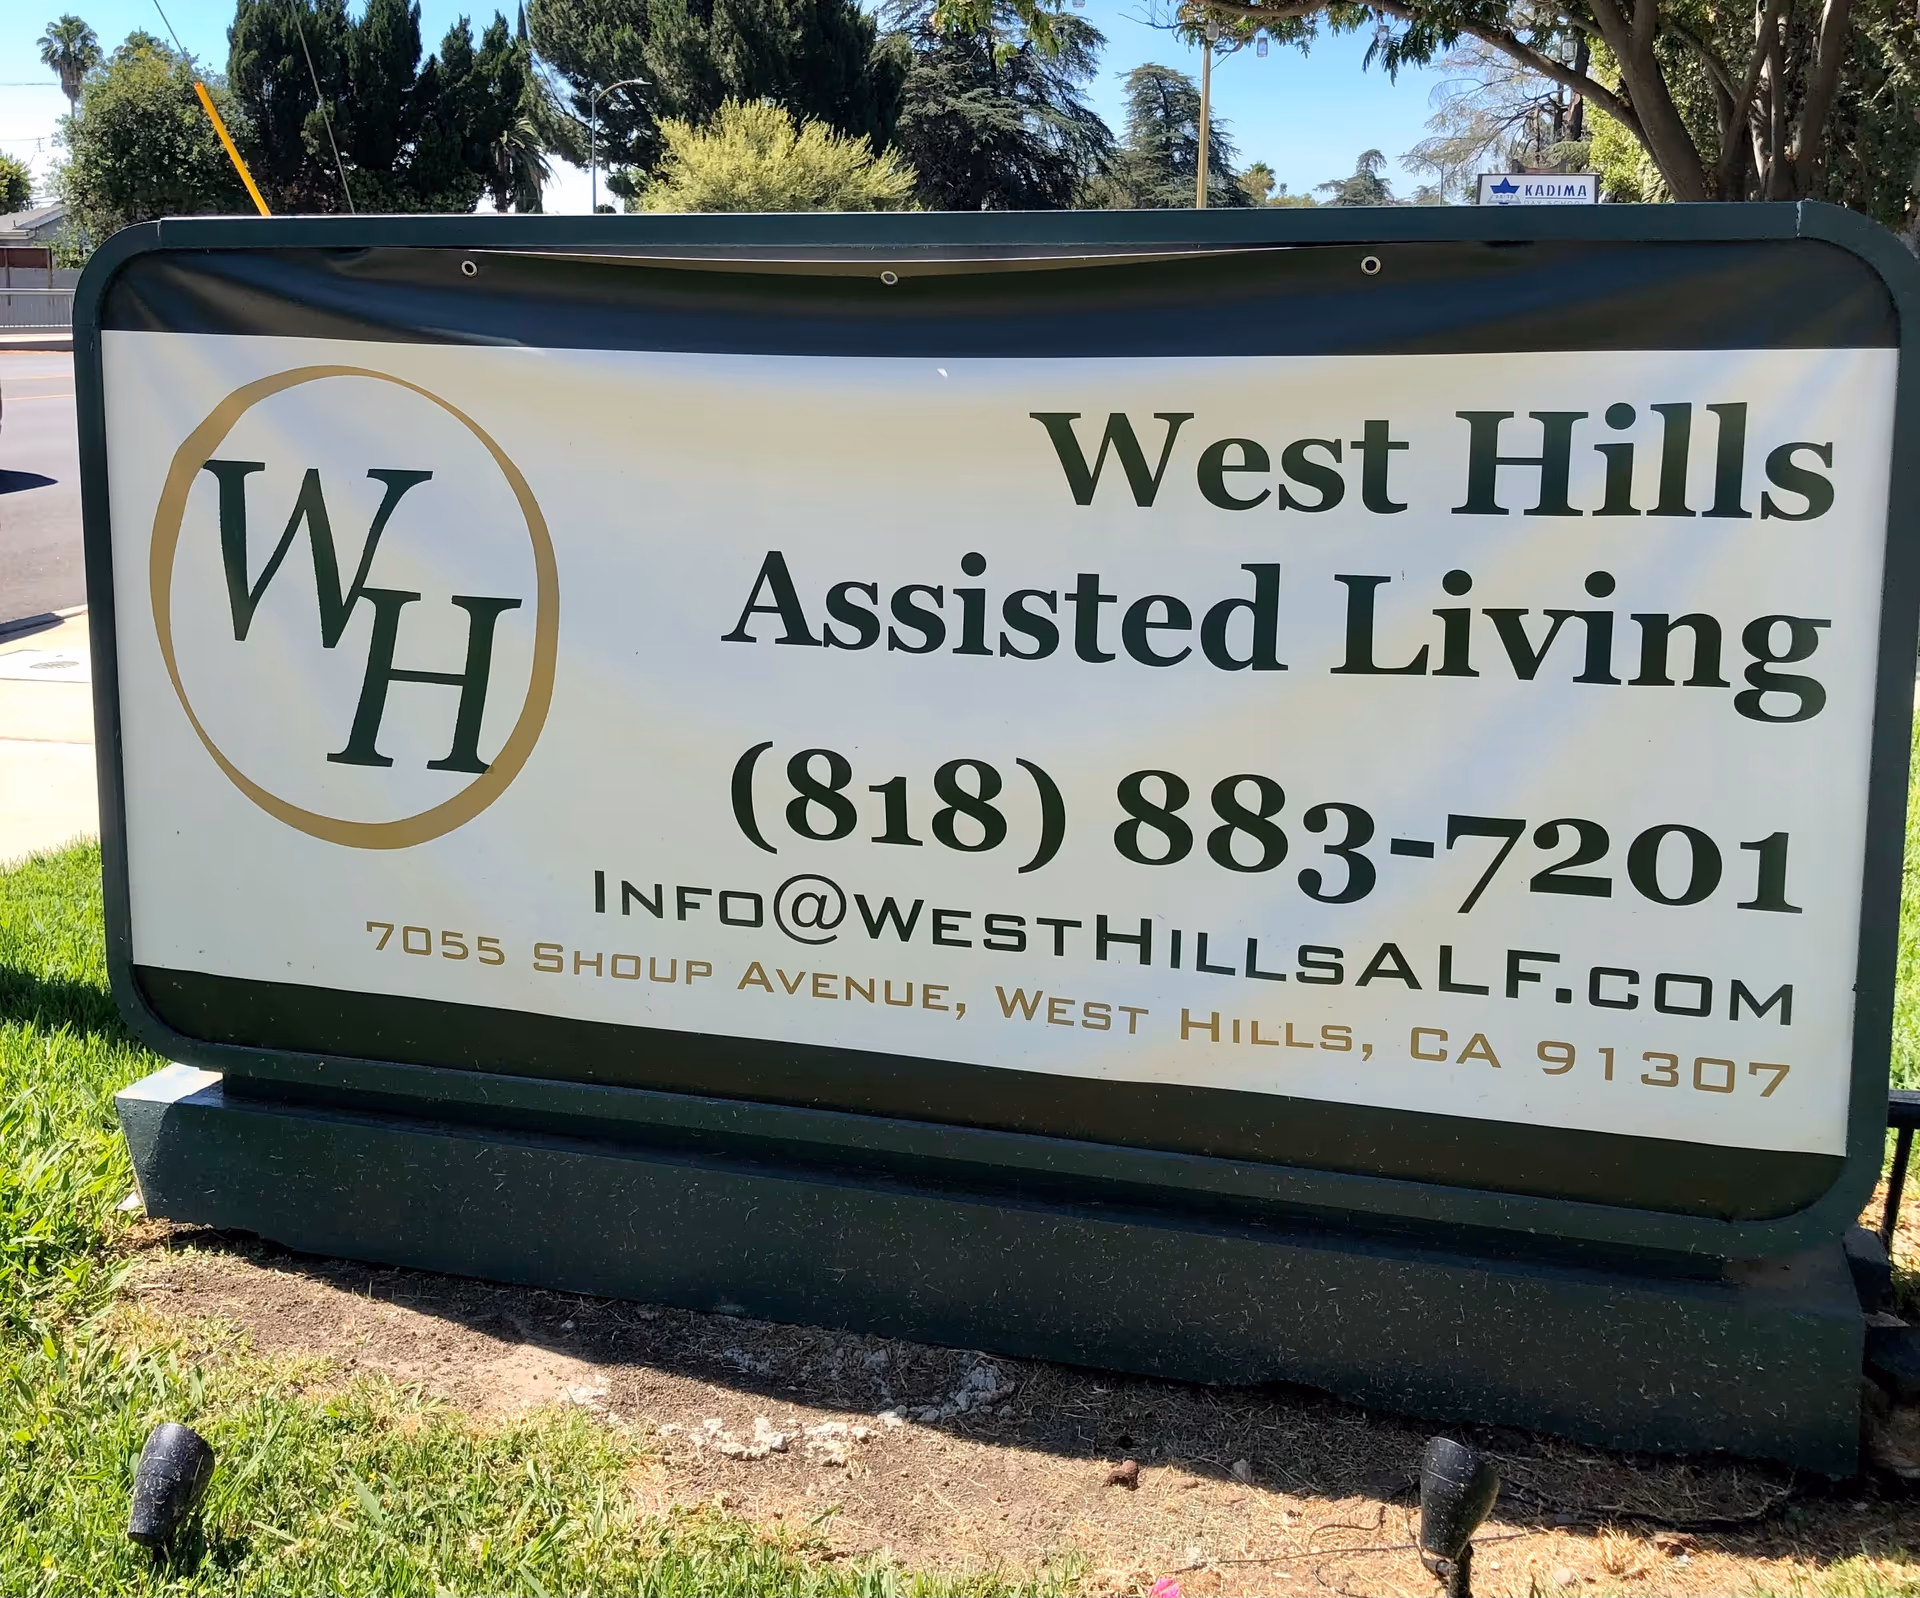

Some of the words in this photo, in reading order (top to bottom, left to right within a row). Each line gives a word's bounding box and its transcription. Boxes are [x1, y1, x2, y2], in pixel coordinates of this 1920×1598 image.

[1525, 184, 1587, 196] KADIMA
[1029, 412, 1410, 514] West
[1451, 402, 1834, 521] Hills
[721, 551, 1288, 671] Assisted
[1330, 569, 1831, 723] Living
[731, 741, 1065, 874] (818)
[1114, 770, 1802, 913] 883-7201
[367, 921, 505, 965] 7055
[533, 943, 713, 984] SHOUP
[737, 962, 966, 1020] AVENUE,
[995, 986, 1149, 1034] WEST
[1181, 1008, 1372, 1062] HILLS,
[1411, 1027, 1501, 1068] CA
[1537, 1041, 1790, 1097] 91307
